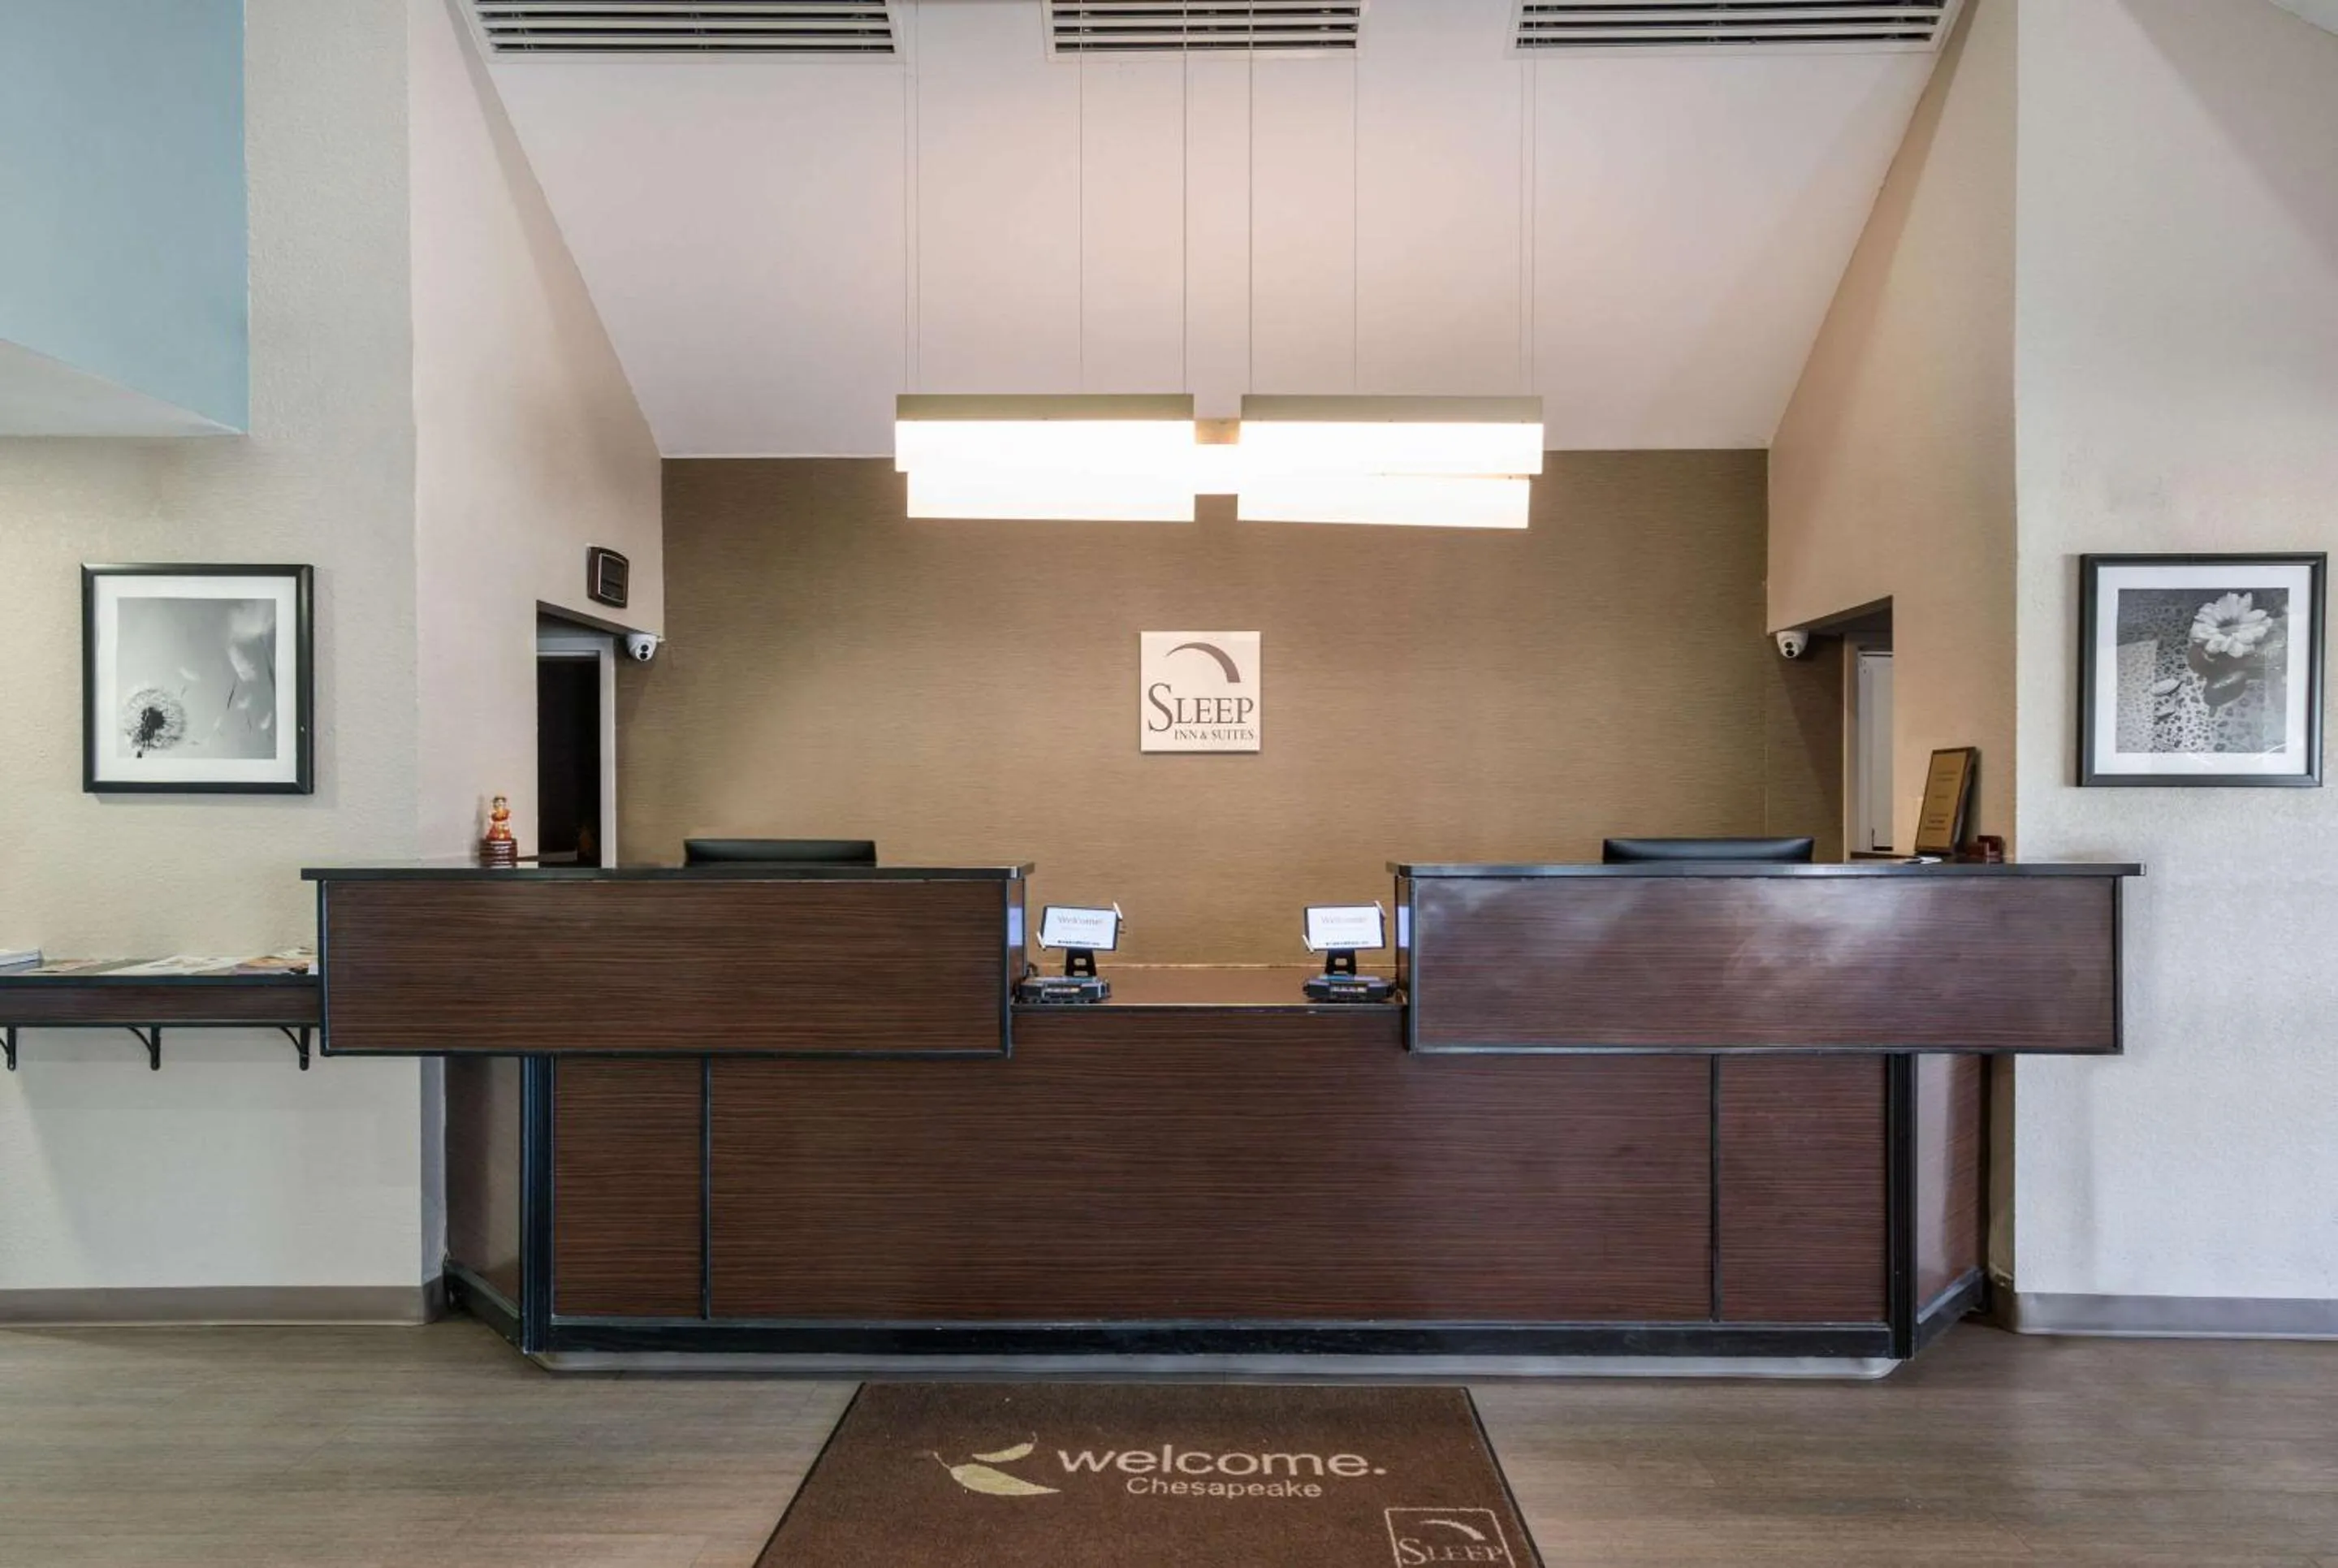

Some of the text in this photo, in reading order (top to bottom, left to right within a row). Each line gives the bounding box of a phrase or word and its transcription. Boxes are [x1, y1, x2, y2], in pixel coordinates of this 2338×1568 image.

[1147, 682, 1254, 732] SLEEP
[1174, 729, 1254, 741] INN & SUITES
[1057, 1444, 1386, 1477] welcome.
[1126, 1476, 1322, 1499] Chesapeake
[1398, 1538, 1502, 1564] SLEEP
